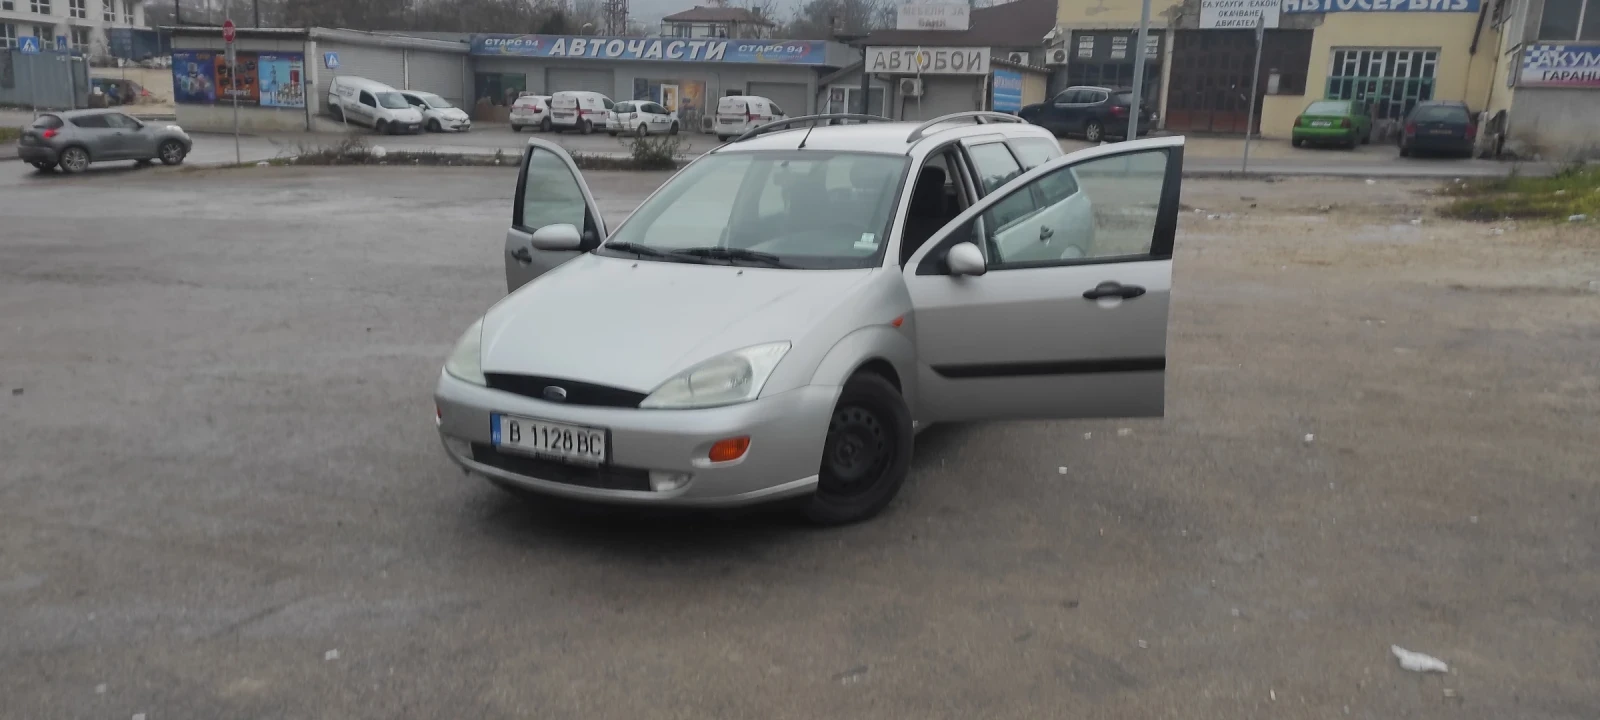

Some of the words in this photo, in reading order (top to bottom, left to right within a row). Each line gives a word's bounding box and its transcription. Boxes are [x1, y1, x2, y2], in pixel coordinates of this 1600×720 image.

[485, 38, 523, 46] СТАРС
[549, 38, 728, 61] АВТОЧАСТИ
[738, 44, 783, 53] СТАРС
[786, 45, 804, 53] 94
[872, 50, 981, 72] АВТОБОИ
[509, 419, 521, 443] B
[531, 423, 573, 452] 1128
[577, 430, 601, 456] BC
